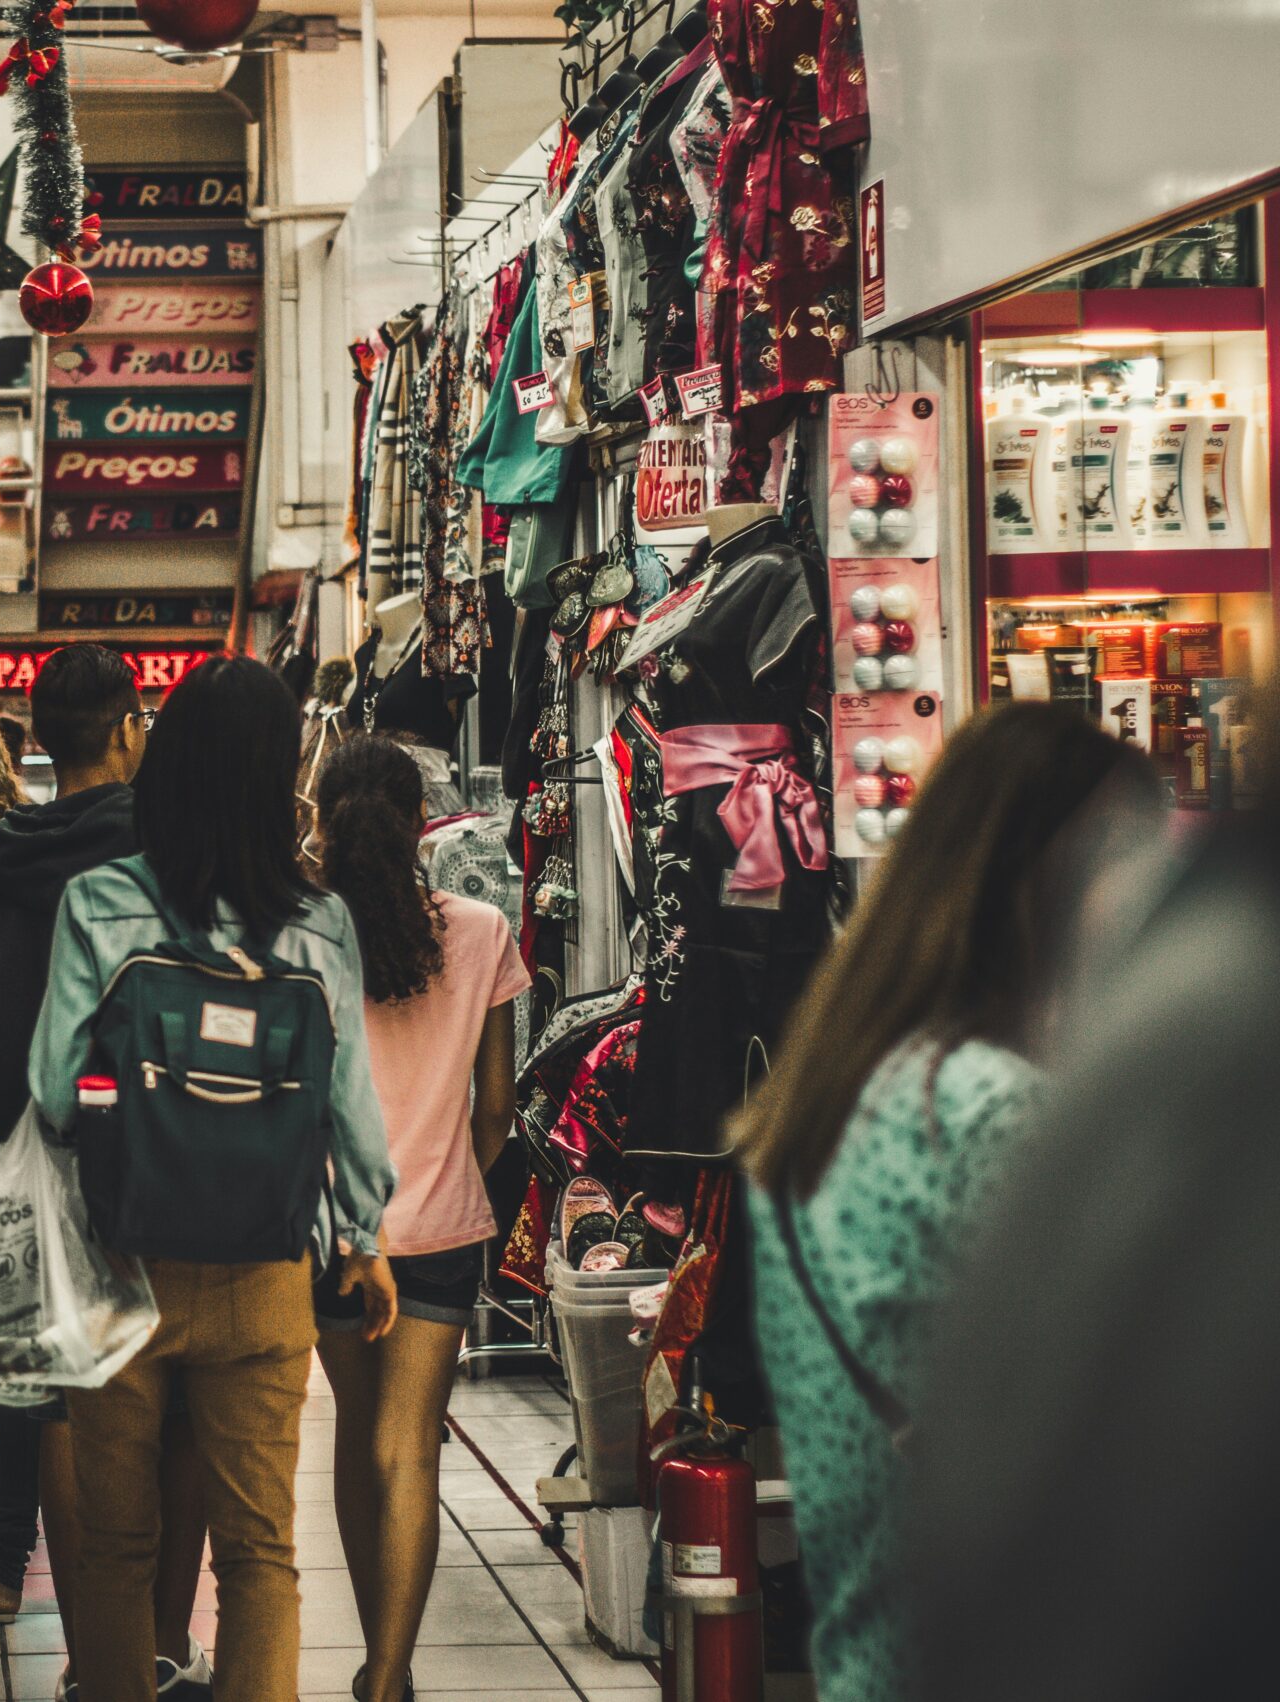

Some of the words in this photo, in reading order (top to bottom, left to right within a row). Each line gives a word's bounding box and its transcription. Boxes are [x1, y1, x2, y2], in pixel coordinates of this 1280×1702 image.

[116, 176, 245, 206] FRALDA
[114, 290, 253, 327] Preços
[109, 343, 256, 374] FRALDAS
[105, 397, 237, 433] Ótimos
[837, 397, 868, 409] eos
[55, 452, 198, 485] Preços
[640, 468, 702, 521] Oferta
[840, 696, 870, 708] eos
